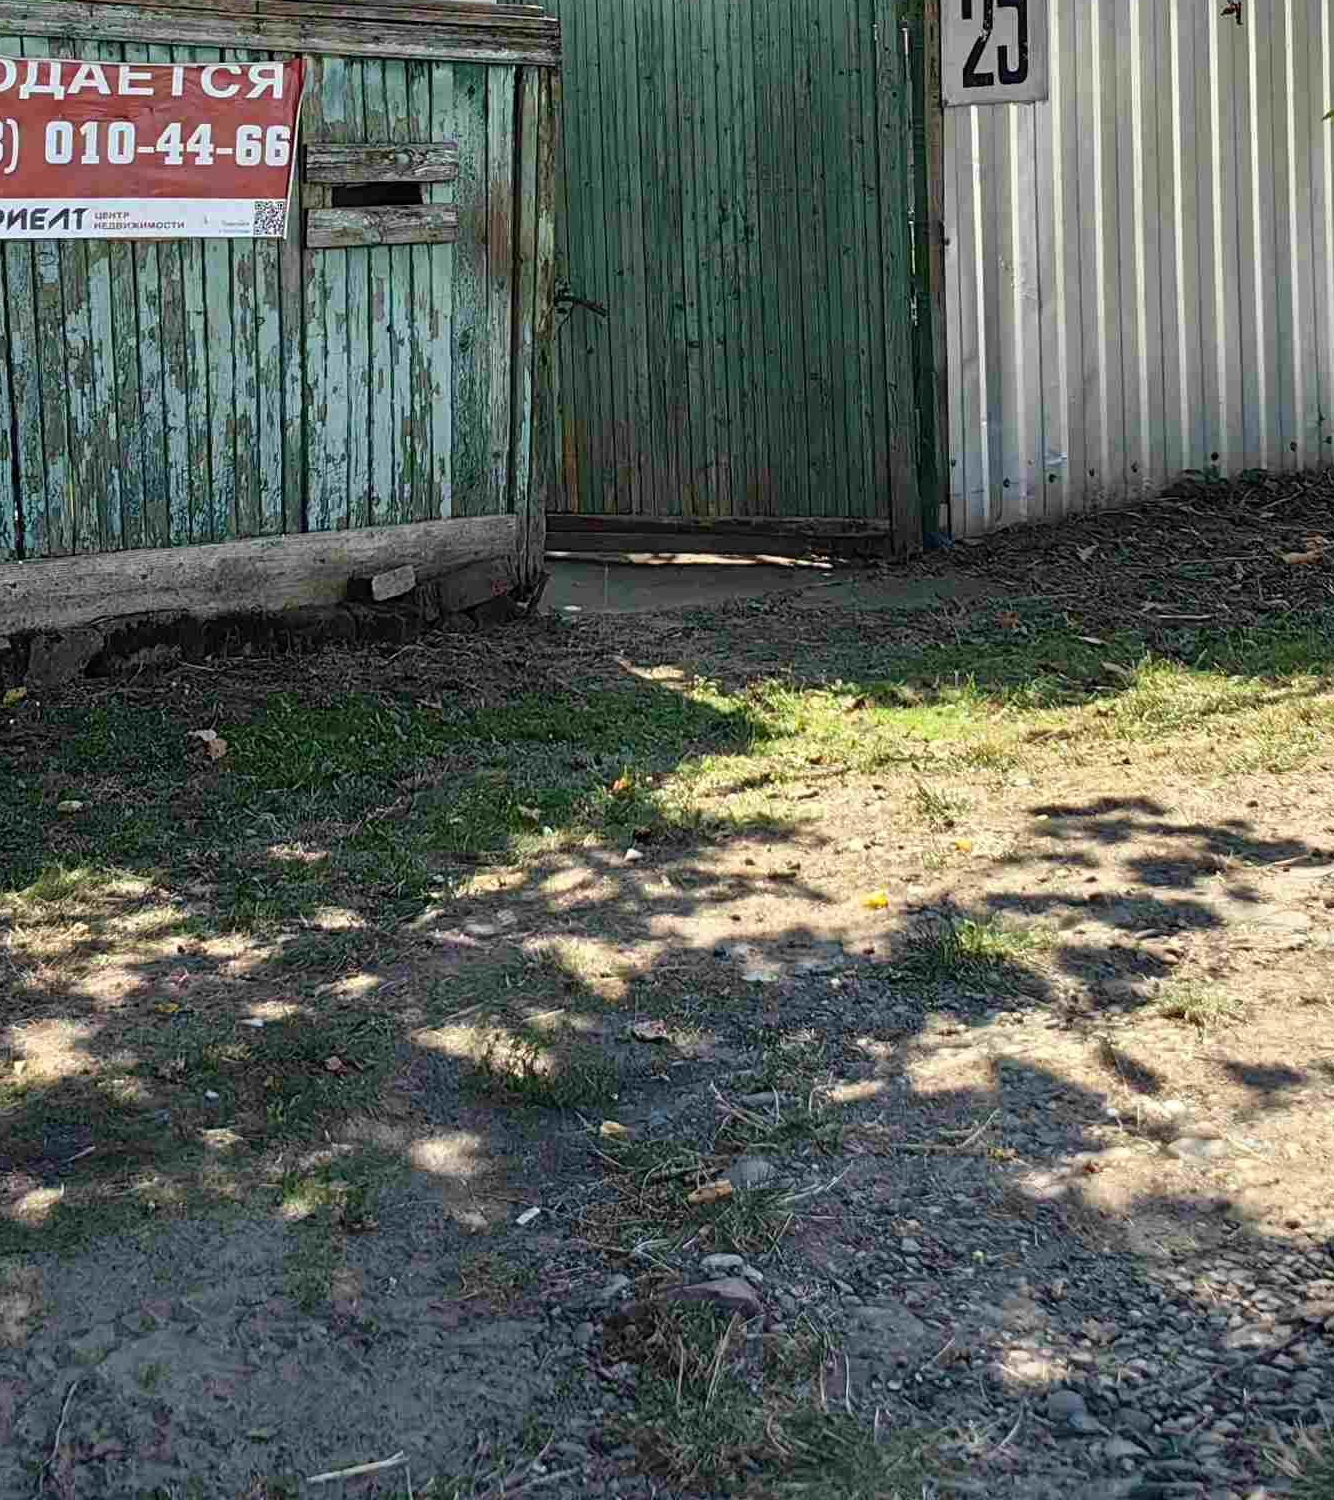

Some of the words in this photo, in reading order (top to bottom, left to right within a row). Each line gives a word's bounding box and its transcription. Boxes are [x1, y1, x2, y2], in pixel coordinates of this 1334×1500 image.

[44, 120, 291, 167] 010-44-66
[94, 211, 130, 220] ЦЕНТР
[93, 221, 185, 230] НЕДВИЖИМОСТИ
